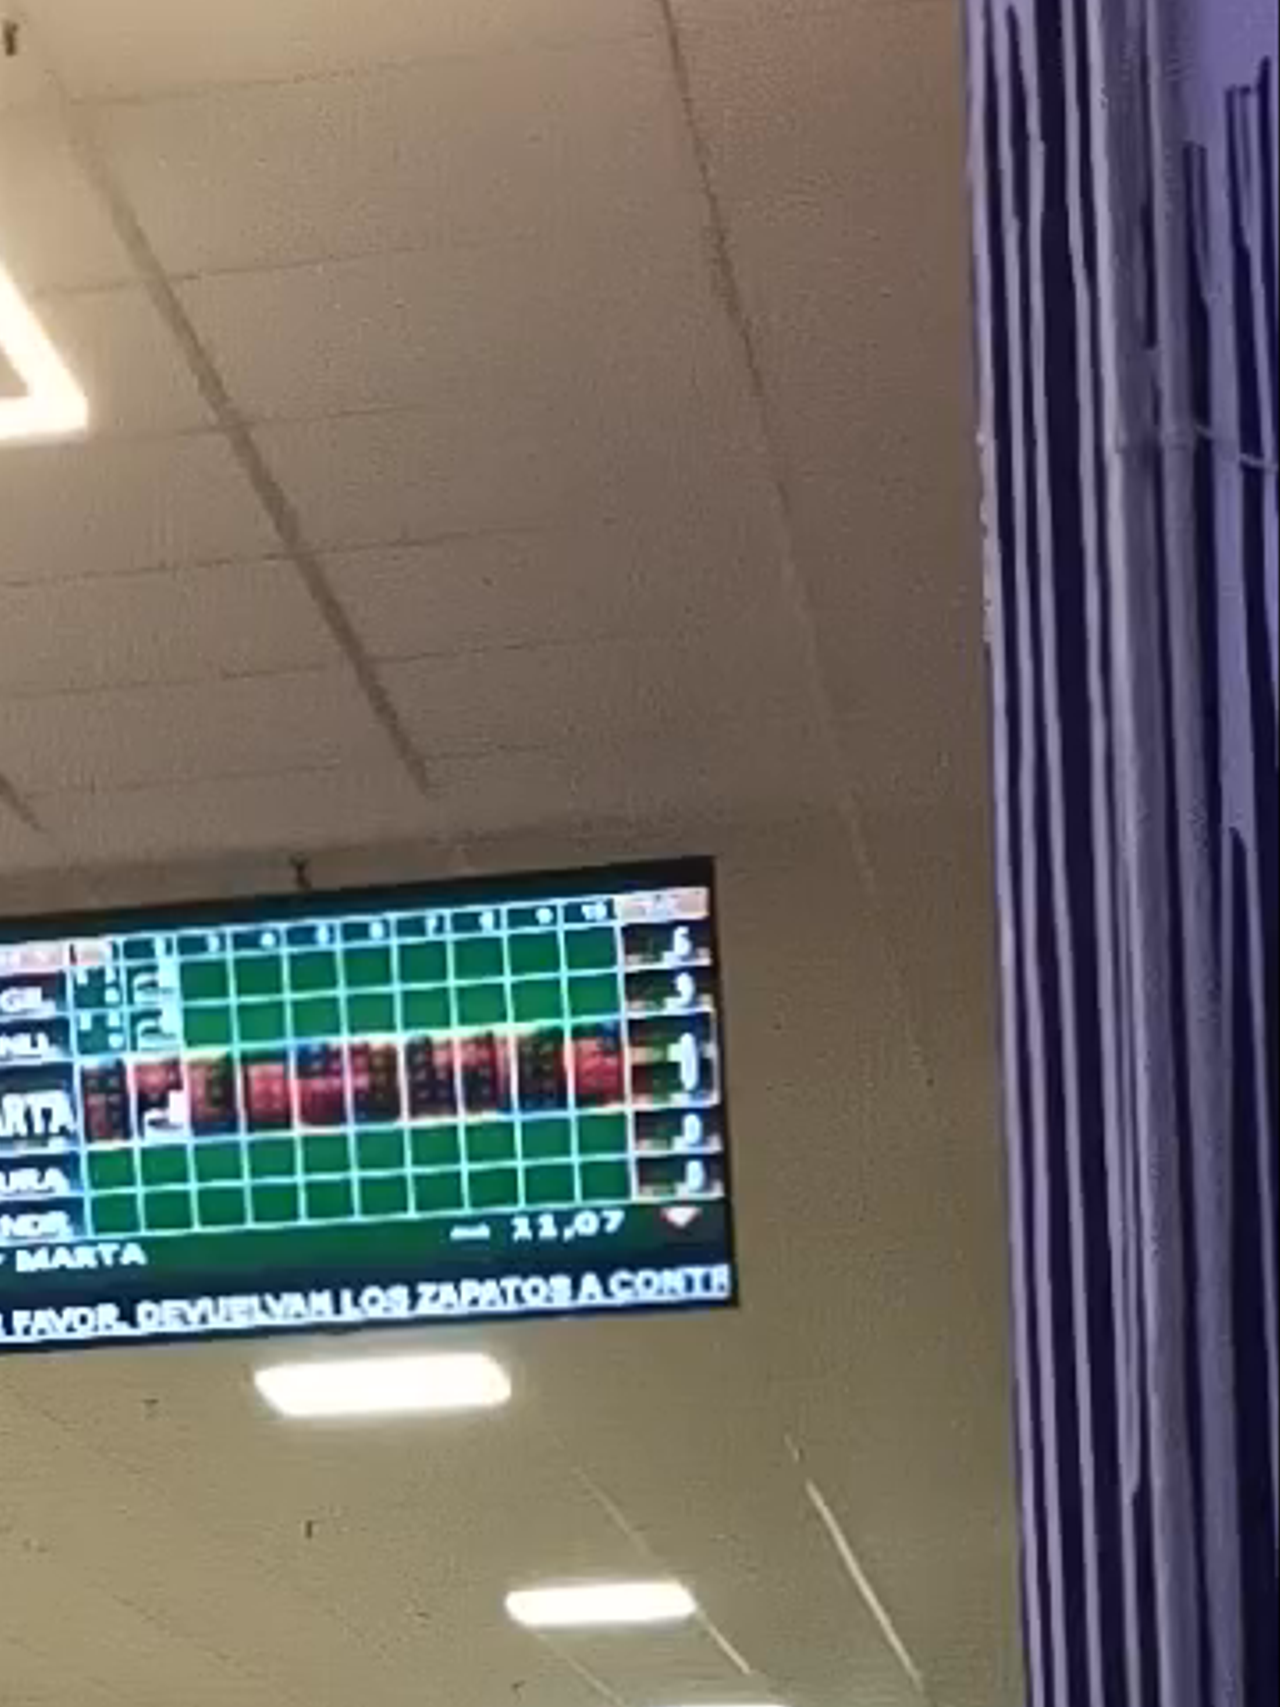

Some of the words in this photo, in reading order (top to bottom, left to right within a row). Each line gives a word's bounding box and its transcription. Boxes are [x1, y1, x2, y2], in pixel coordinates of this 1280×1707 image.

[15, 1242, 147, 1272] MARTA
[340, 1283, 412, 1323] LOS
[417, 1276, 571, 1317] ZAPATOS
[578, 1273, 604, 1305] A
